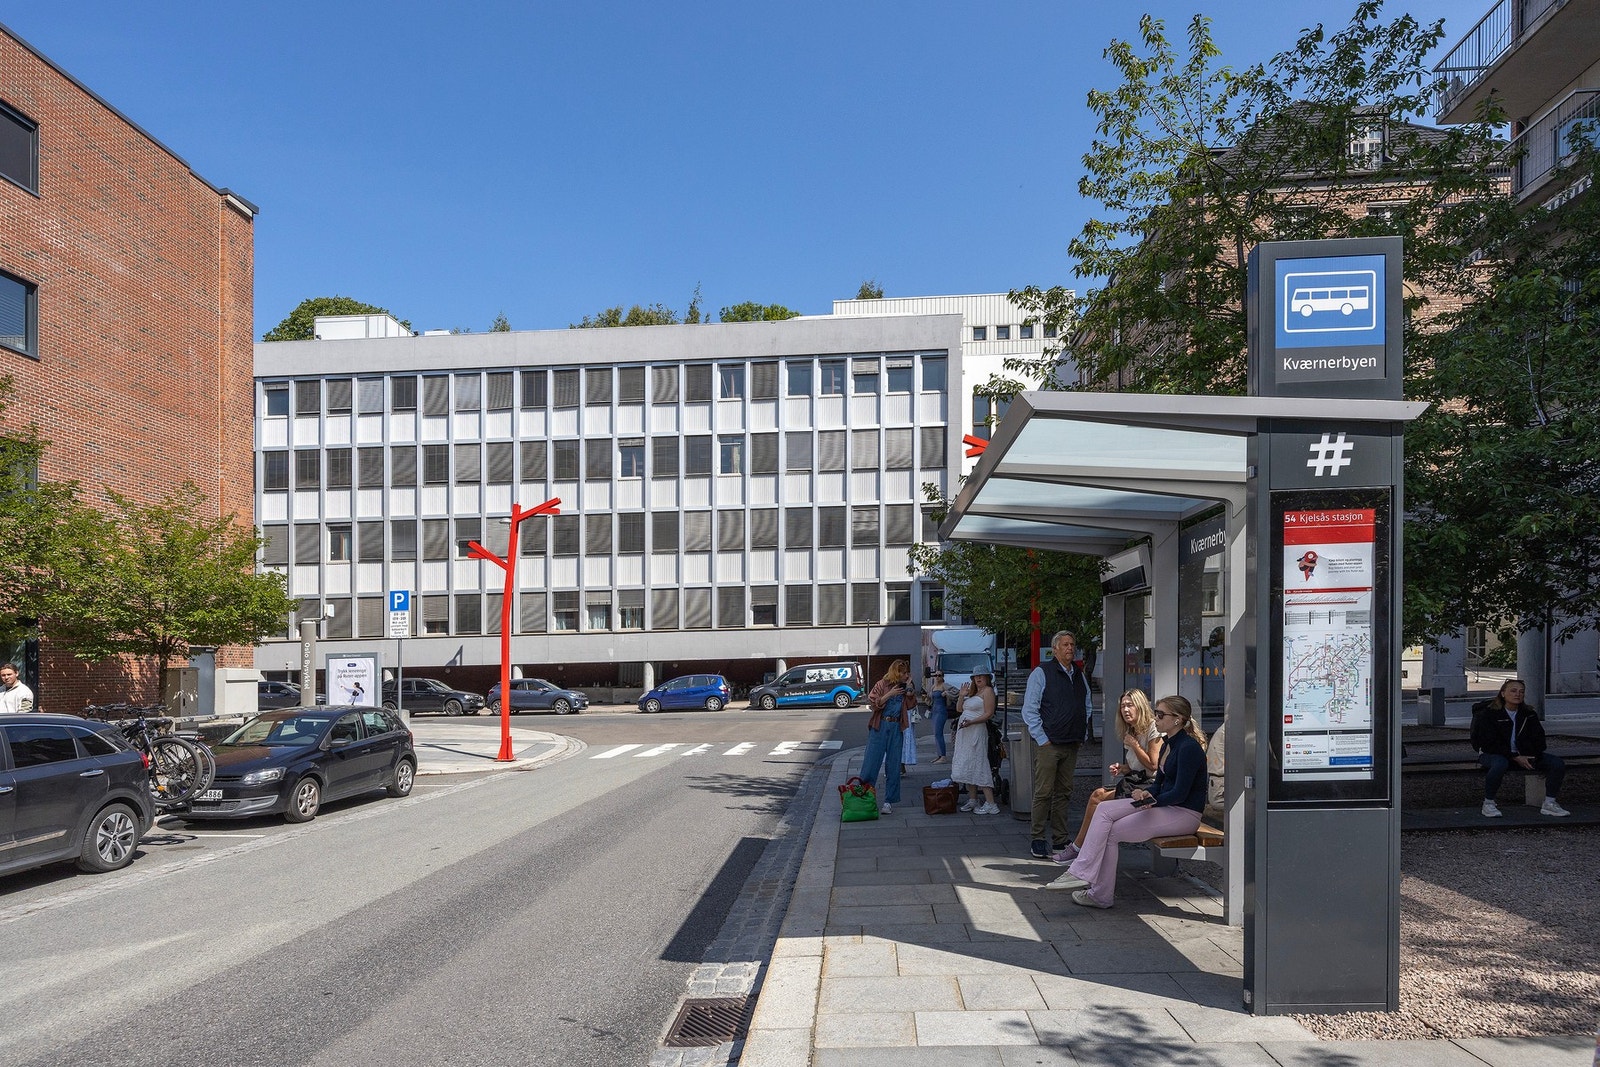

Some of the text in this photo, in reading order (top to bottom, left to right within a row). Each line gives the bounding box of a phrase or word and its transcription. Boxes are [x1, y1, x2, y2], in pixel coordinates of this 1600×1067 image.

[1283, 356, 1377, 371] Kværnerbyen
[1284, 512, 1363, 524] 54 Kjelsås stasjon
[394, 592, 405, 609] P
[303, 659, 311, 690] Bysykkel
